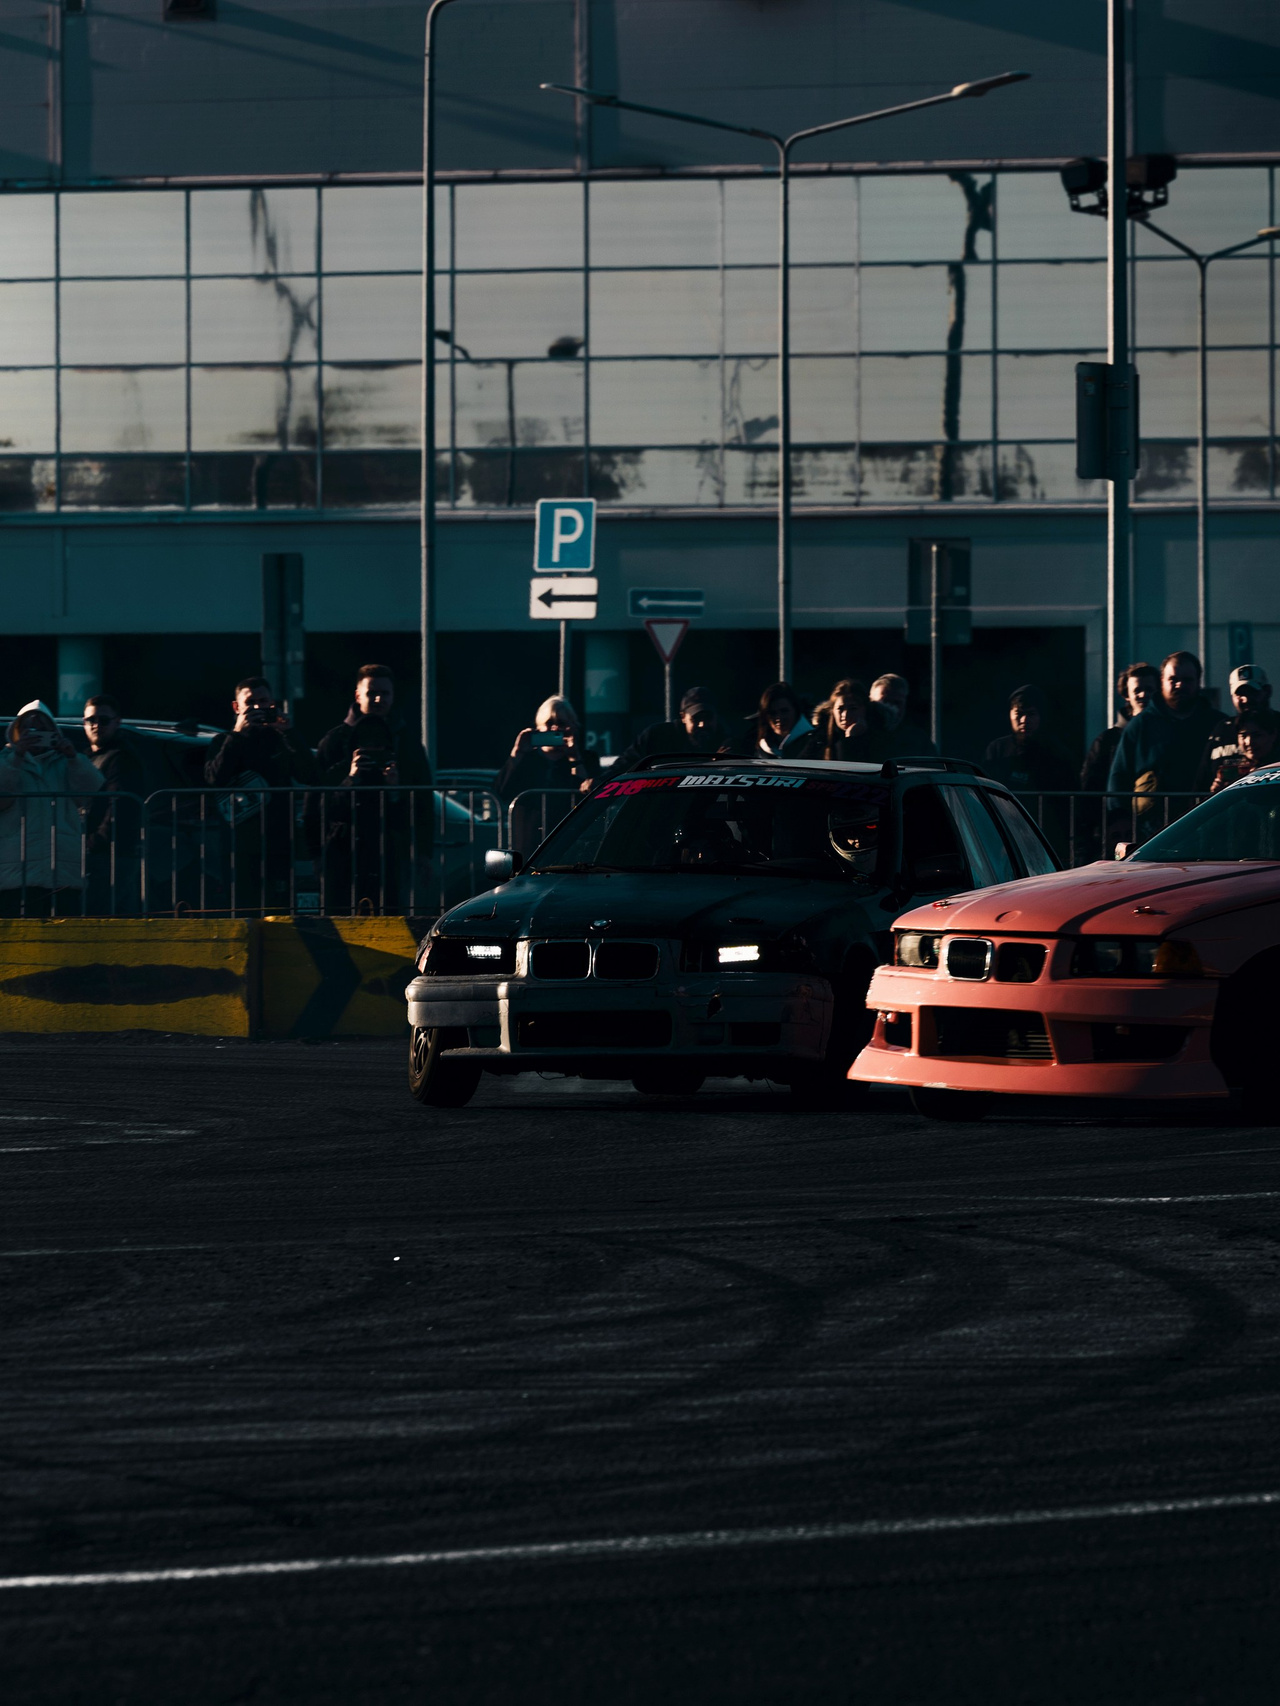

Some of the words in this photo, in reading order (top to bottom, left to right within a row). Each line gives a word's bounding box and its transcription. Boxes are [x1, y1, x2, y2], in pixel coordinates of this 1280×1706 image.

[551, 508, 585, 563] P
[585, 731, 611, 753] P1
[594, 779, 646, 799] 218
[677, 774, 807, 789] MATSURI
